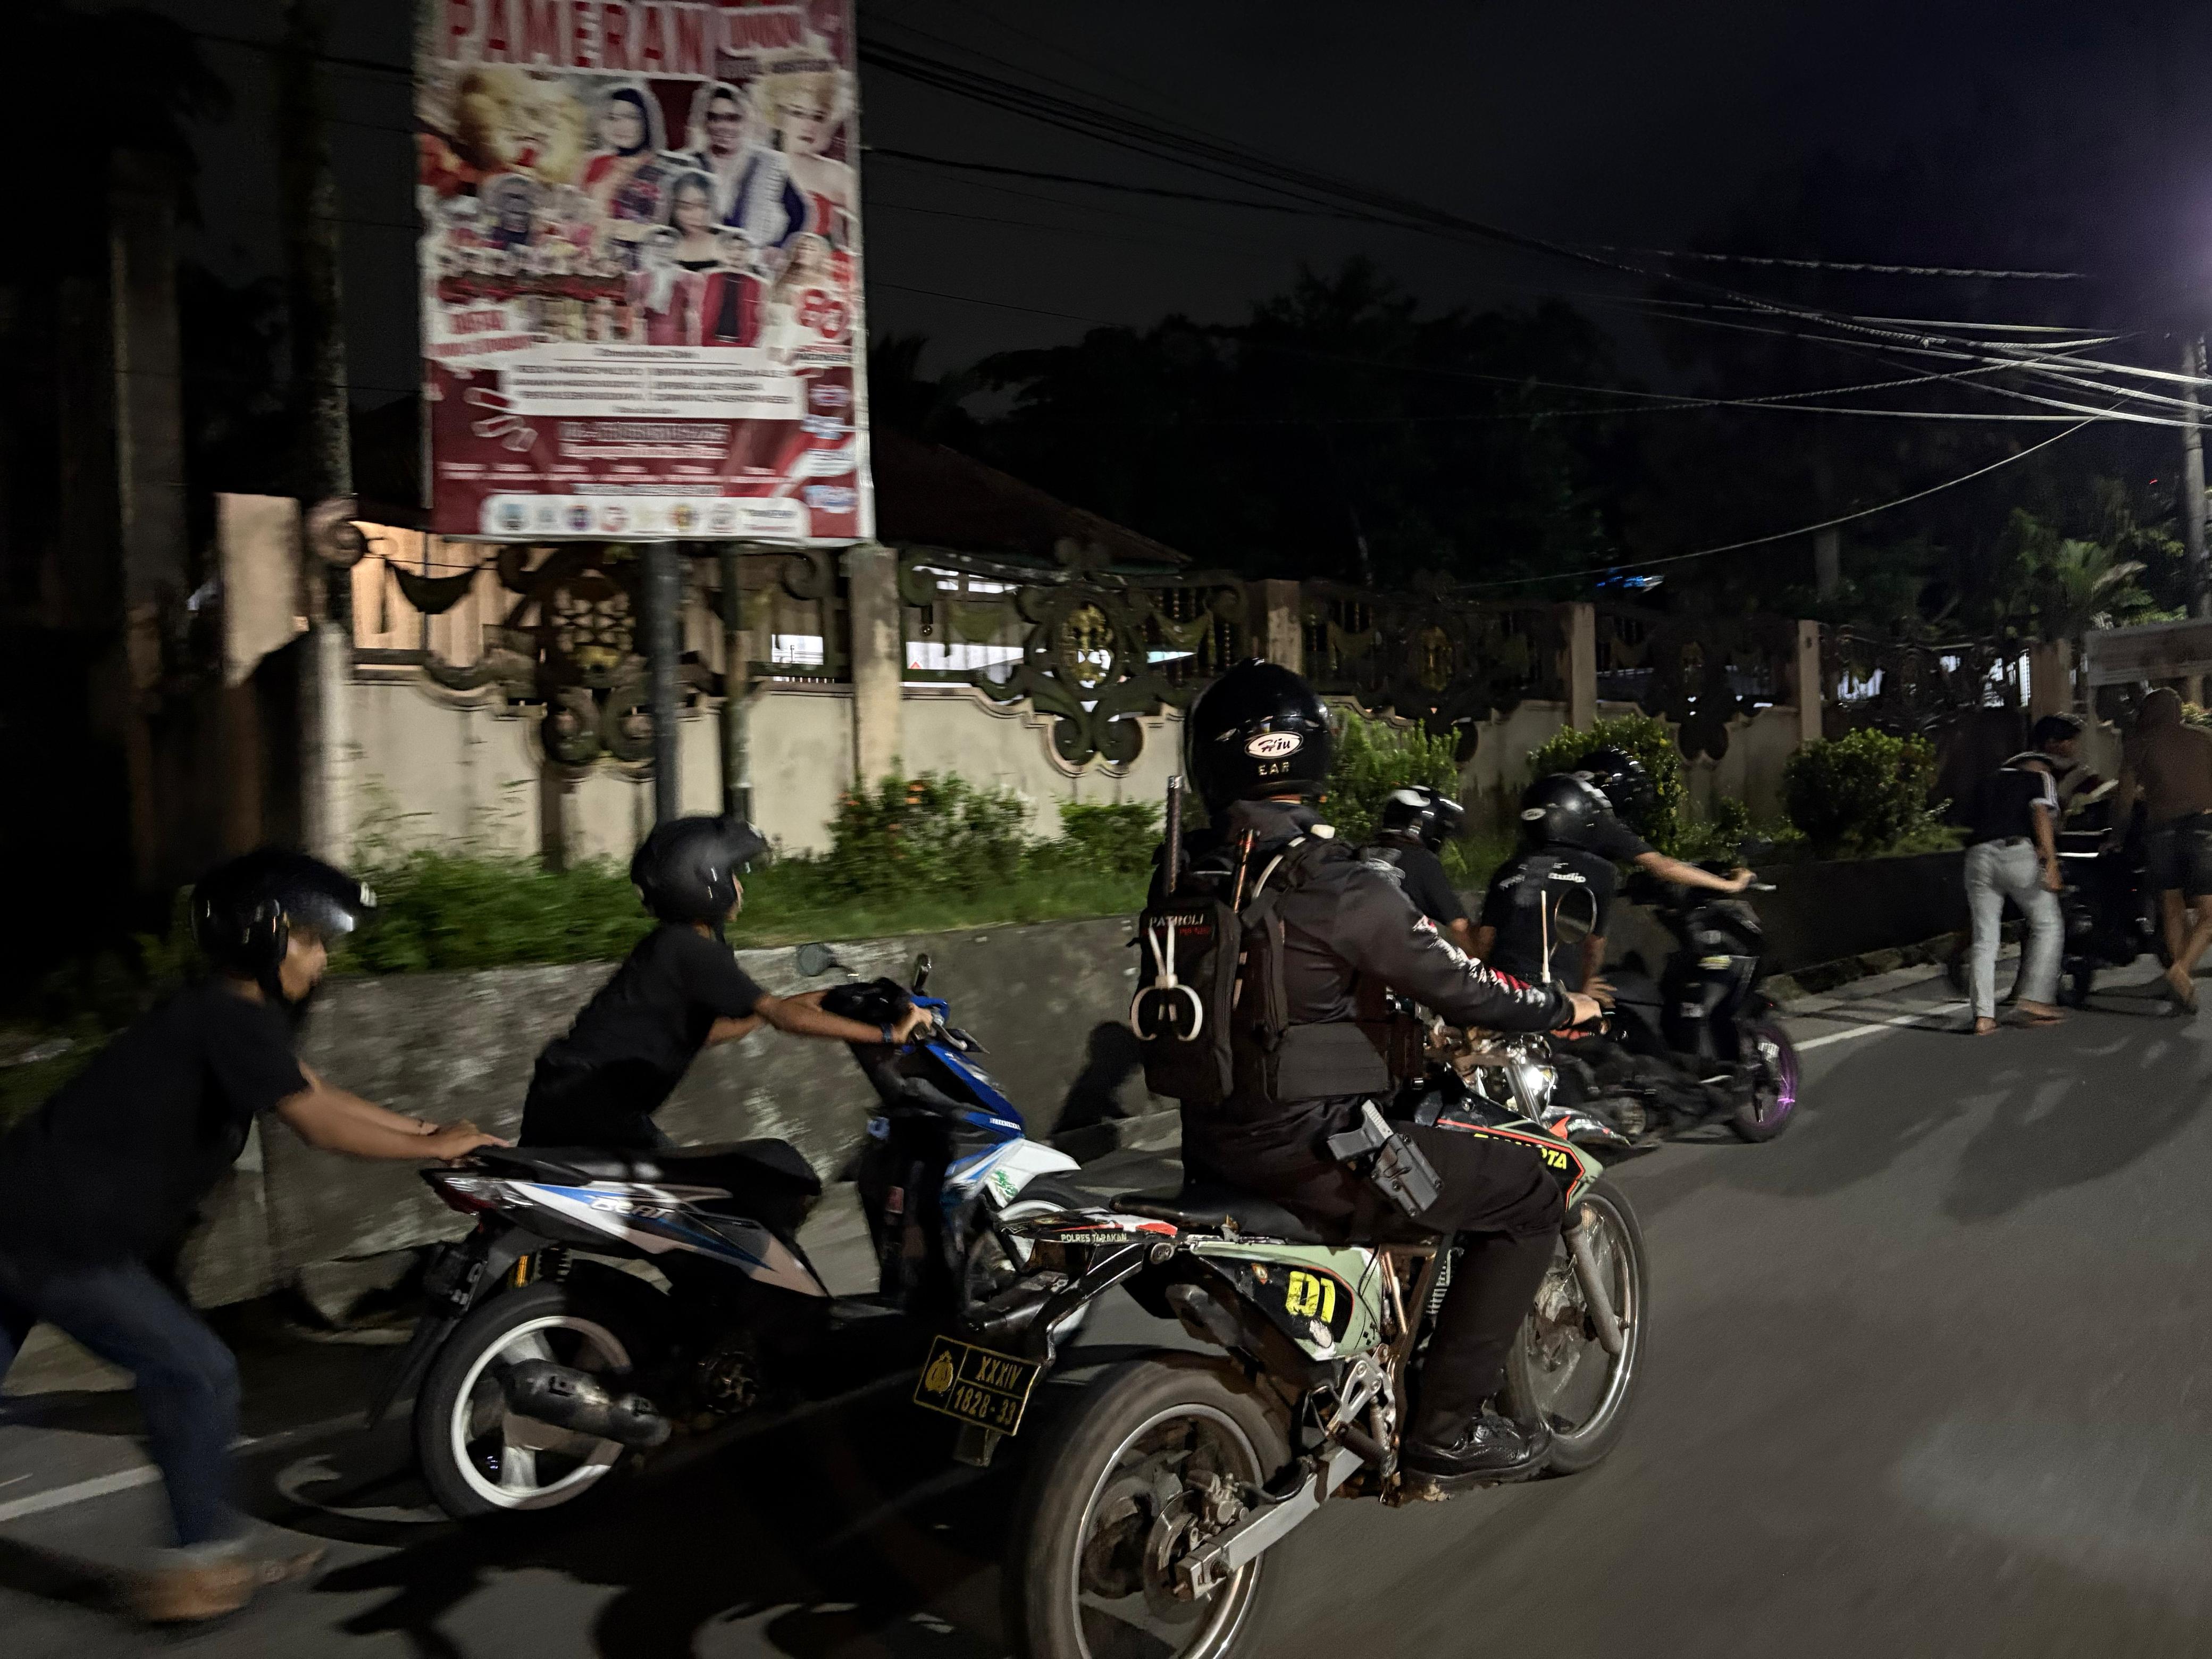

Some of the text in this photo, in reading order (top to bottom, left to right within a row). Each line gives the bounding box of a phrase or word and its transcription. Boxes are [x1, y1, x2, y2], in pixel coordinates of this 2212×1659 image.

[1149, 913, 1204, 927] PATROLI
[1060, 1233, 1127, 1242] POLRES TARAKAN
[975, 1356, 1023, 1389] XXXIV
